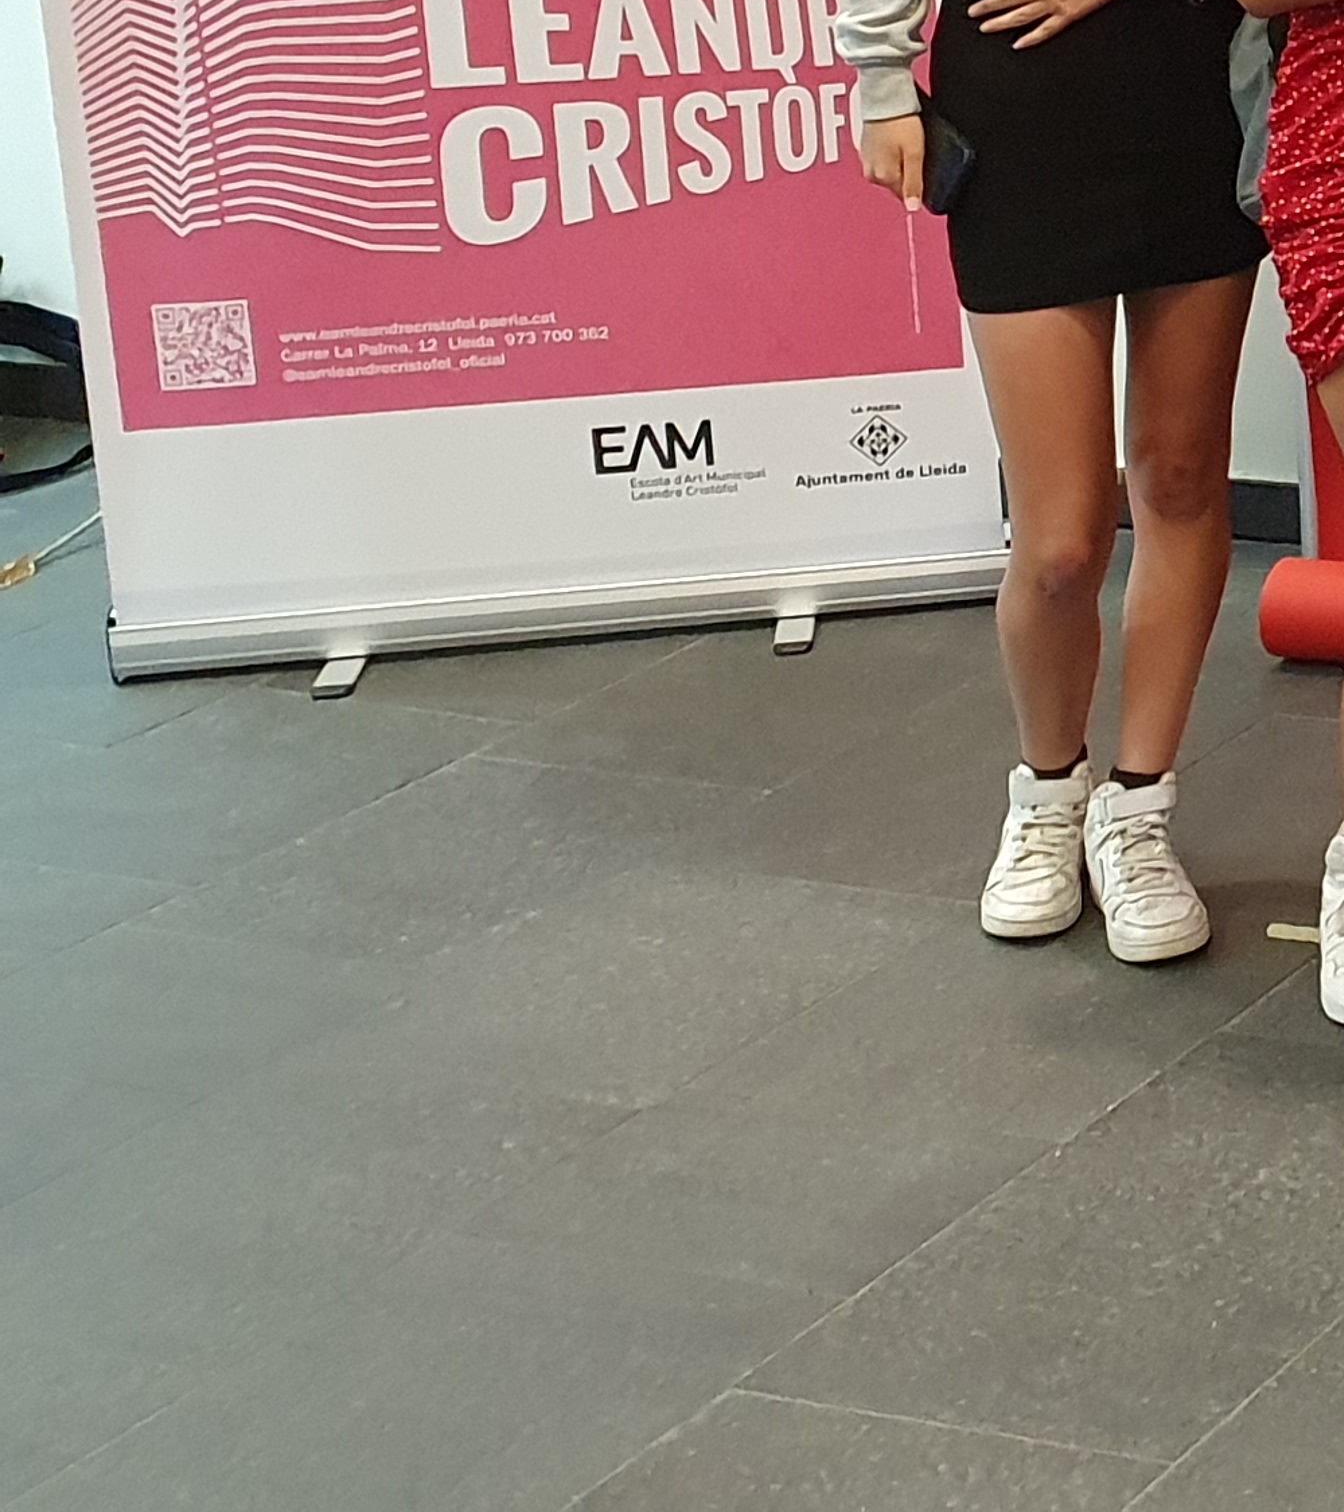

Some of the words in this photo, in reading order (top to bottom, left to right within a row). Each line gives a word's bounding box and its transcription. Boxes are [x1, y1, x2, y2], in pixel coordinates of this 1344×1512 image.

[439, 65, 863, 246] CRISTÒF
[334, 346, 353, 358] La
[419, 338, 438, 352] 12
[504, 331, 537, 347] 973
[542, 328, 573, 343] 700
[578, 326, 609, 341] 362
[592, 419, 714, 475] EAM
[795, 470, 890, 488] Ajuntament
[896, 468, 914, 479] de
[920, 463, 967, 477] Lleida
